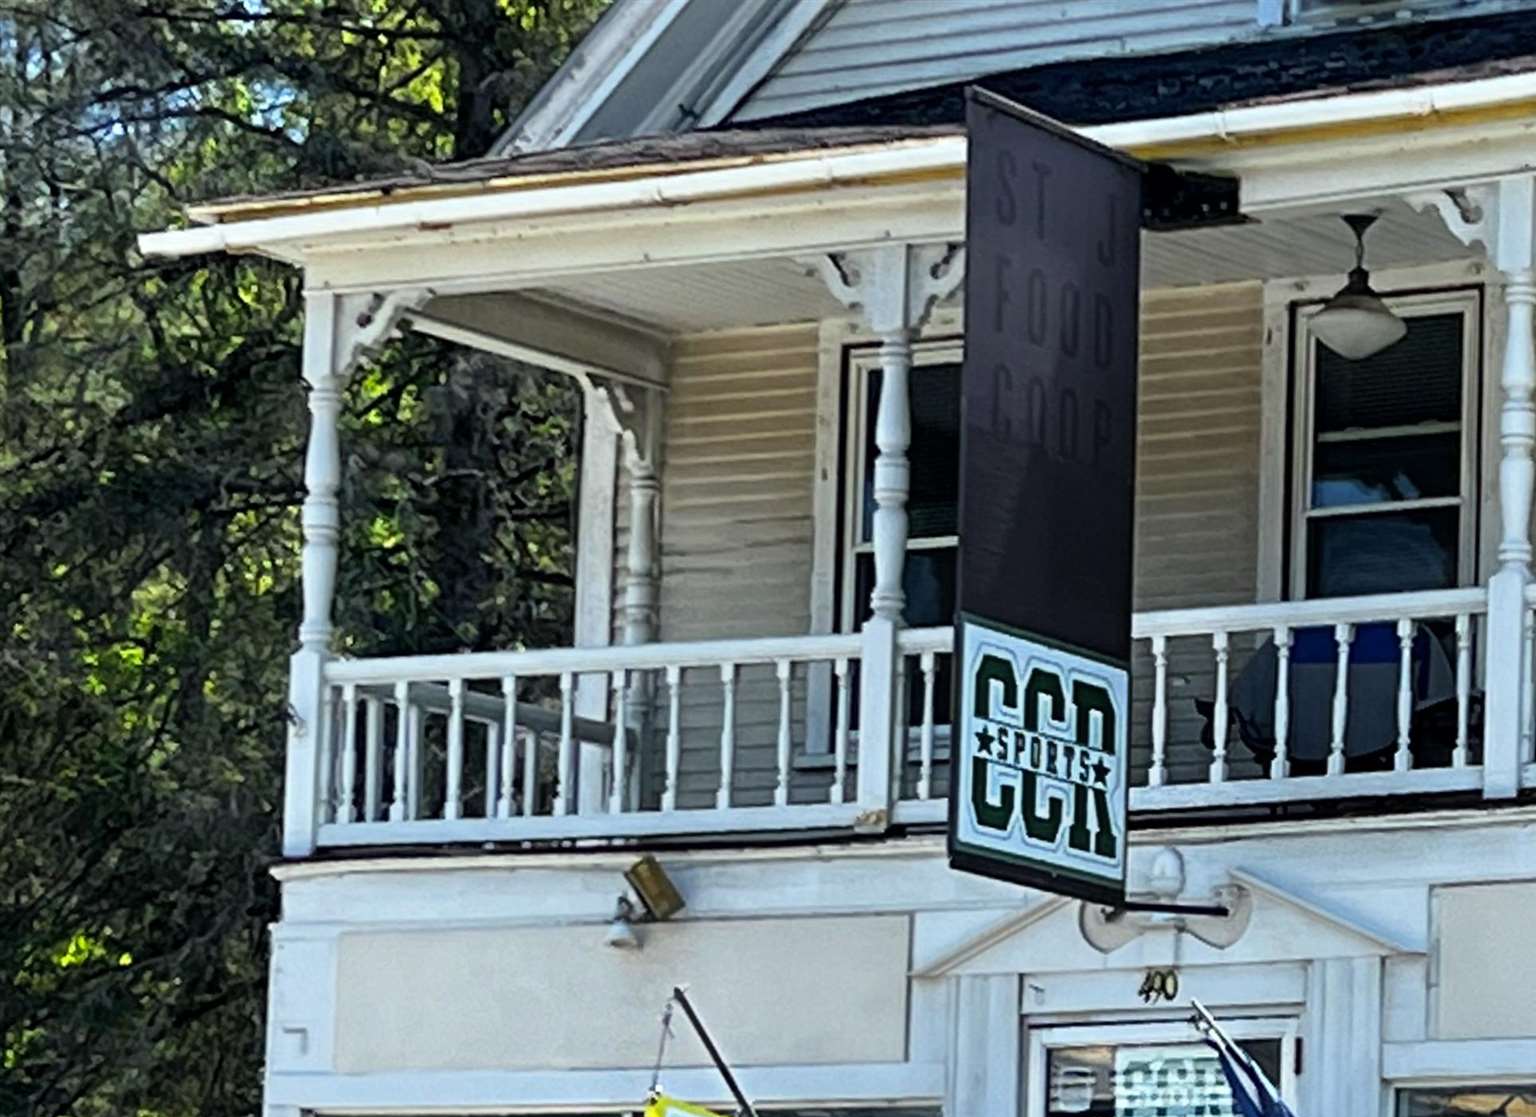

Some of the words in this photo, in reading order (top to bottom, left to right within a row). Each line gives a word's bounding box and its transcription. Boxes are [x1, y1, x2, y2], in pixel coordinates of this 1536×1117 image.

[992, 254, 1114, 369] FOOD
[971, 653, 1117, 859] CCR
[996, 727, 1091, 783] SPORTS
[1138, 969, 1178, 1004] 490
